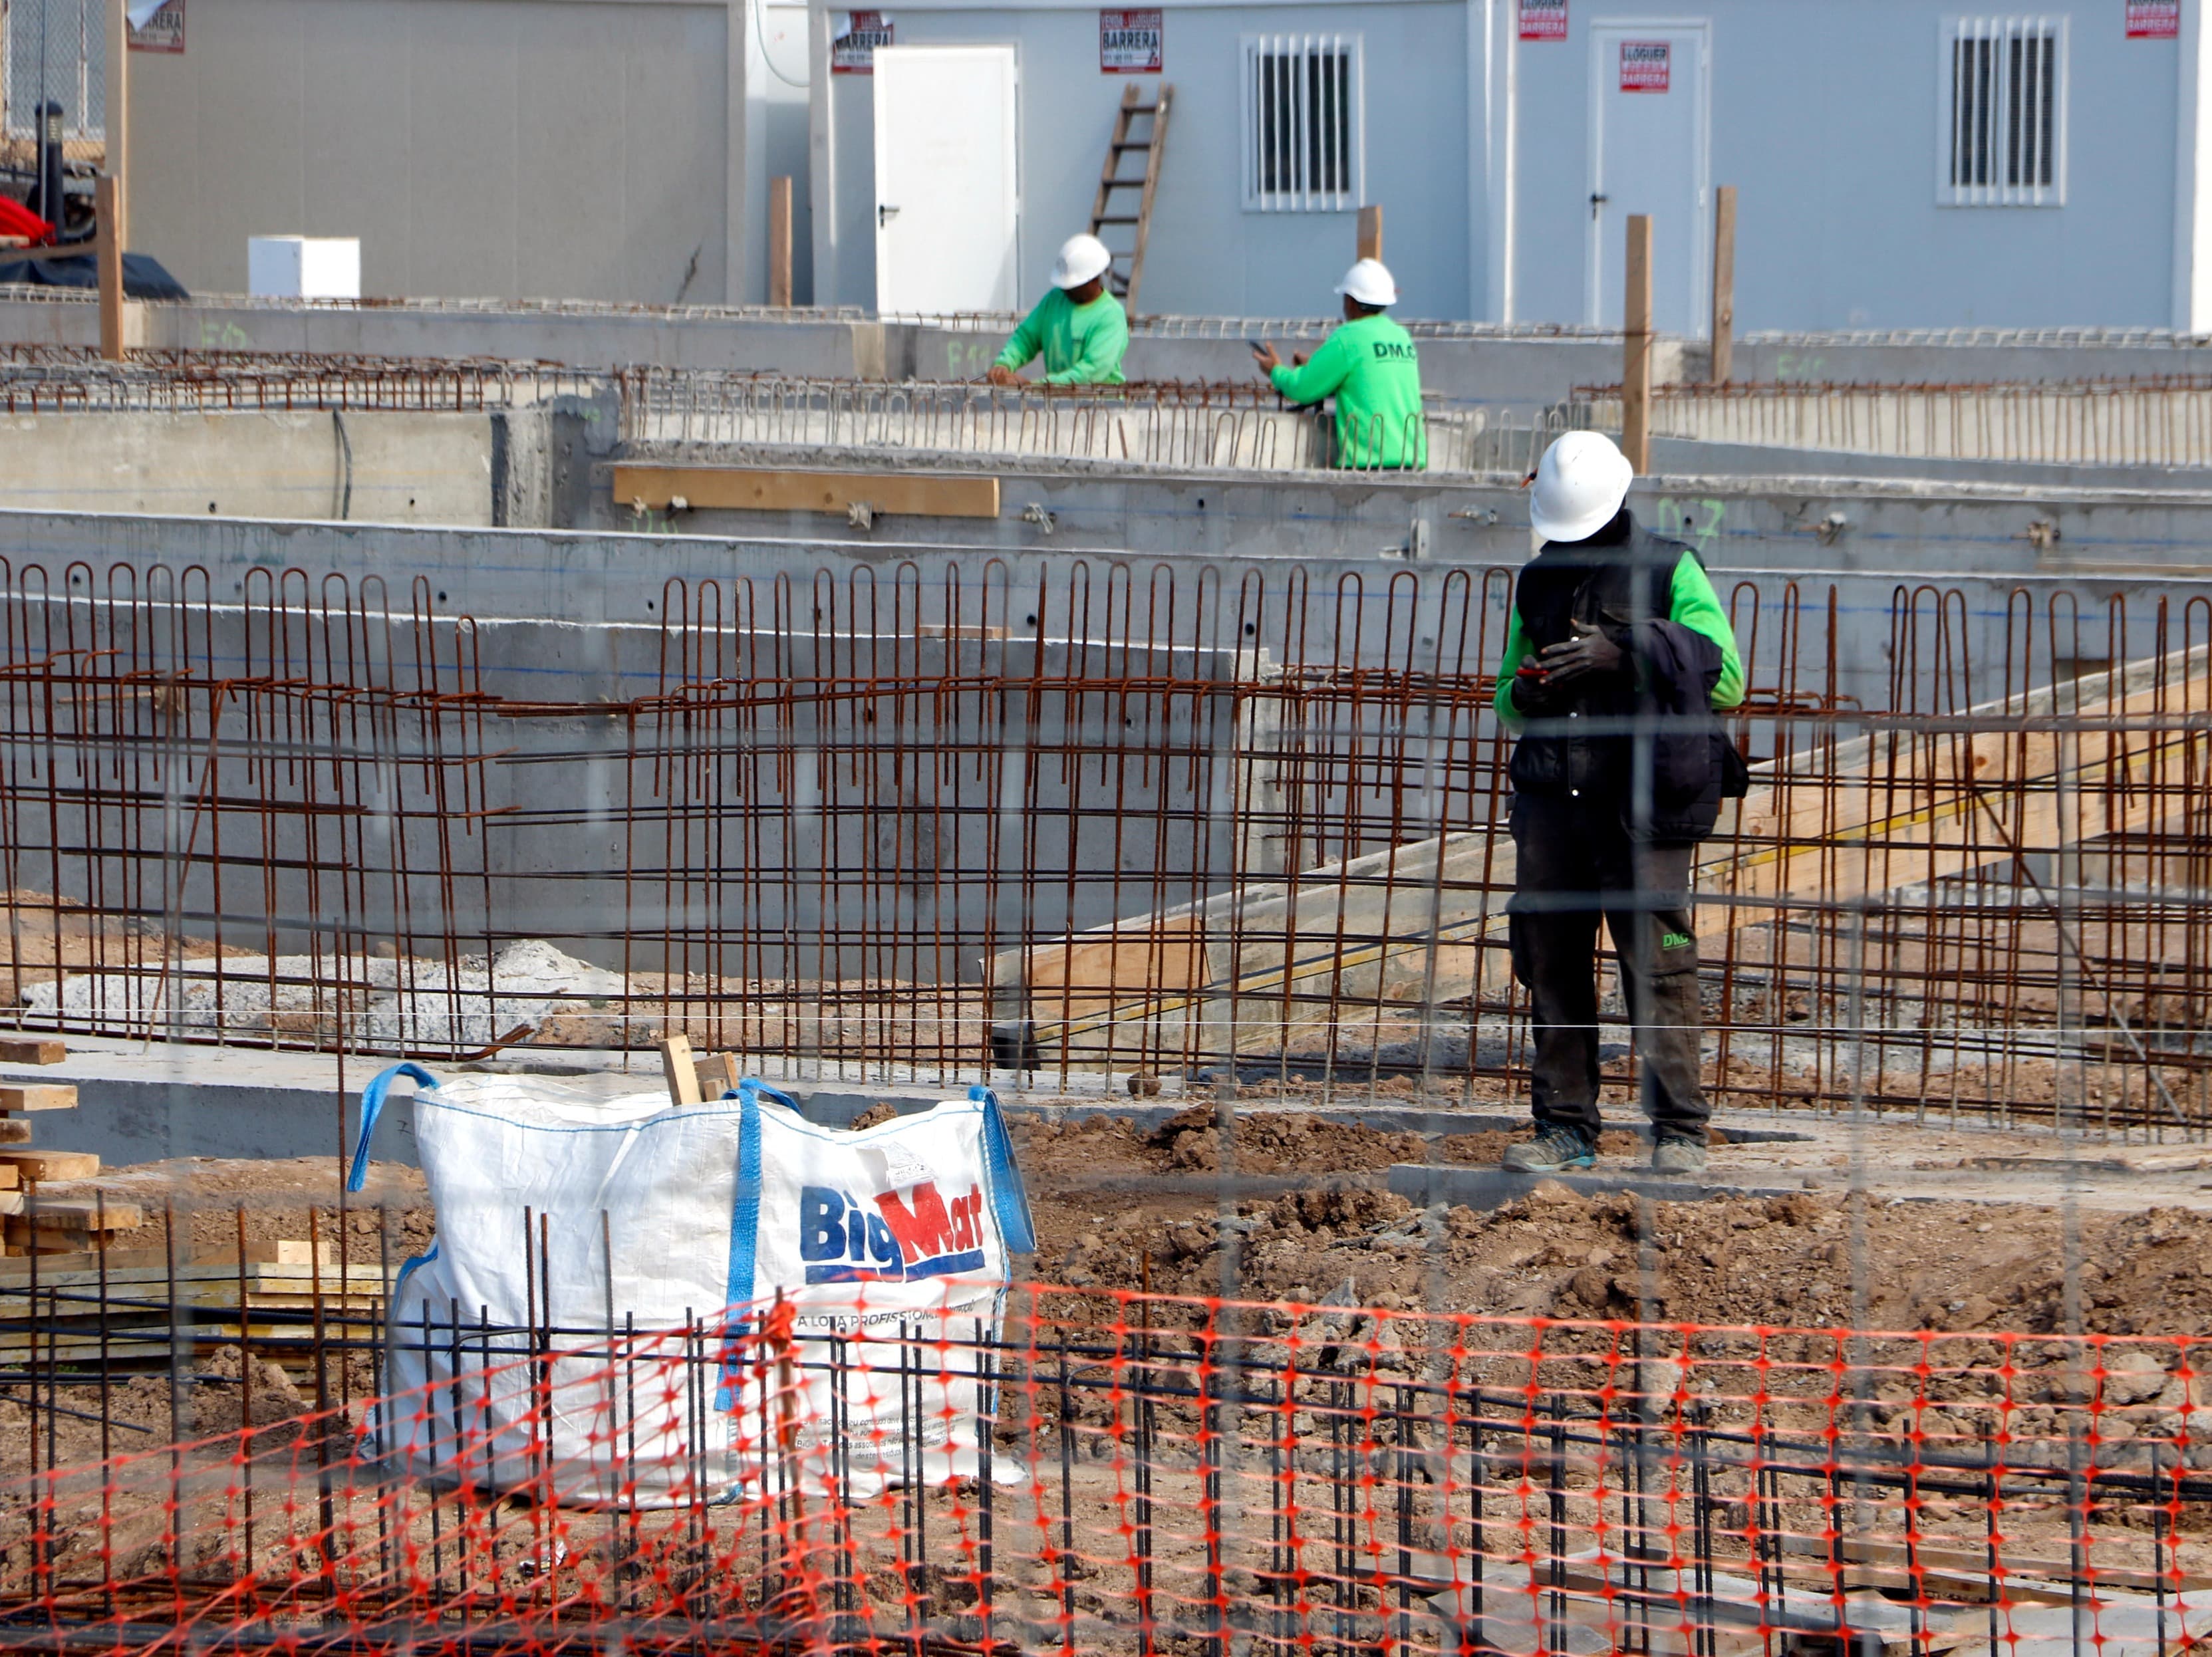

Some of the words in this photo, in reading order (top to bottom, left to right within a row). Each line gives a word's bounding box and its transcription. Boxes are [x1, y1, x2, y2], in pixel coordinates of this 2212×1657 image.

[1103, 31, 1158, 51] BARRERA
[1623, 47, 1666, 61] LLOGUER
[799, 1182, 984, 1283] BigMat
[798, 1316, 808, 1327] A
[811, 1315, 847, 1328] LOA
[851, 1309, 938, 1328] PROFISSION
